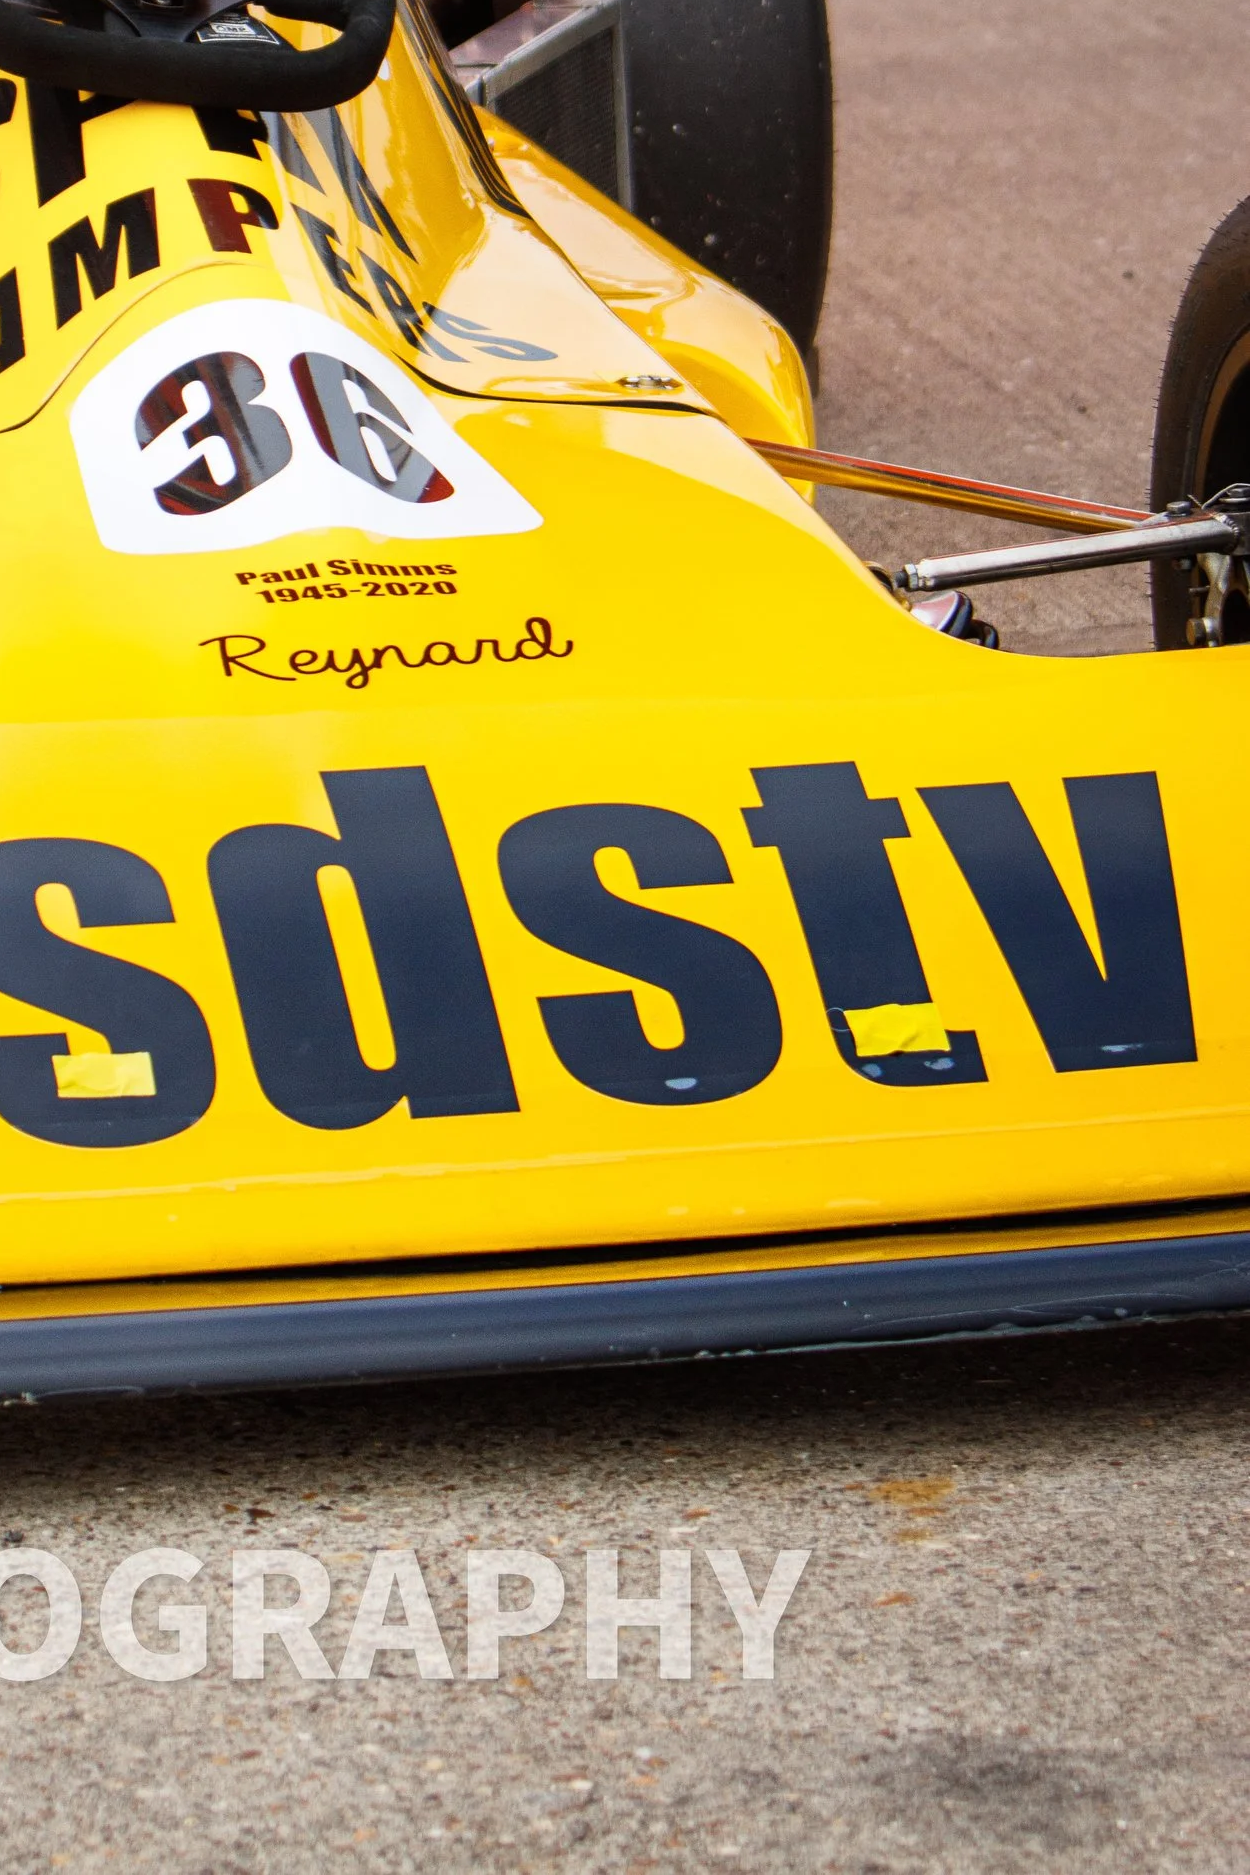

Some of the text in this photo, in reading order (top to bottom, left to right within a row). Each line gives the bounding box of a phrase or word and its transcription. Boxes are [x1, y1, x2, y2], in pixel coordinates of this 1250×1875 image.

[134, 350, 455, 517] 36
[234, 558, 458, 586] Paul Simms
[254, 579, 458, 604] 1945-2020
[198, 616, 574, 690] Reynard
